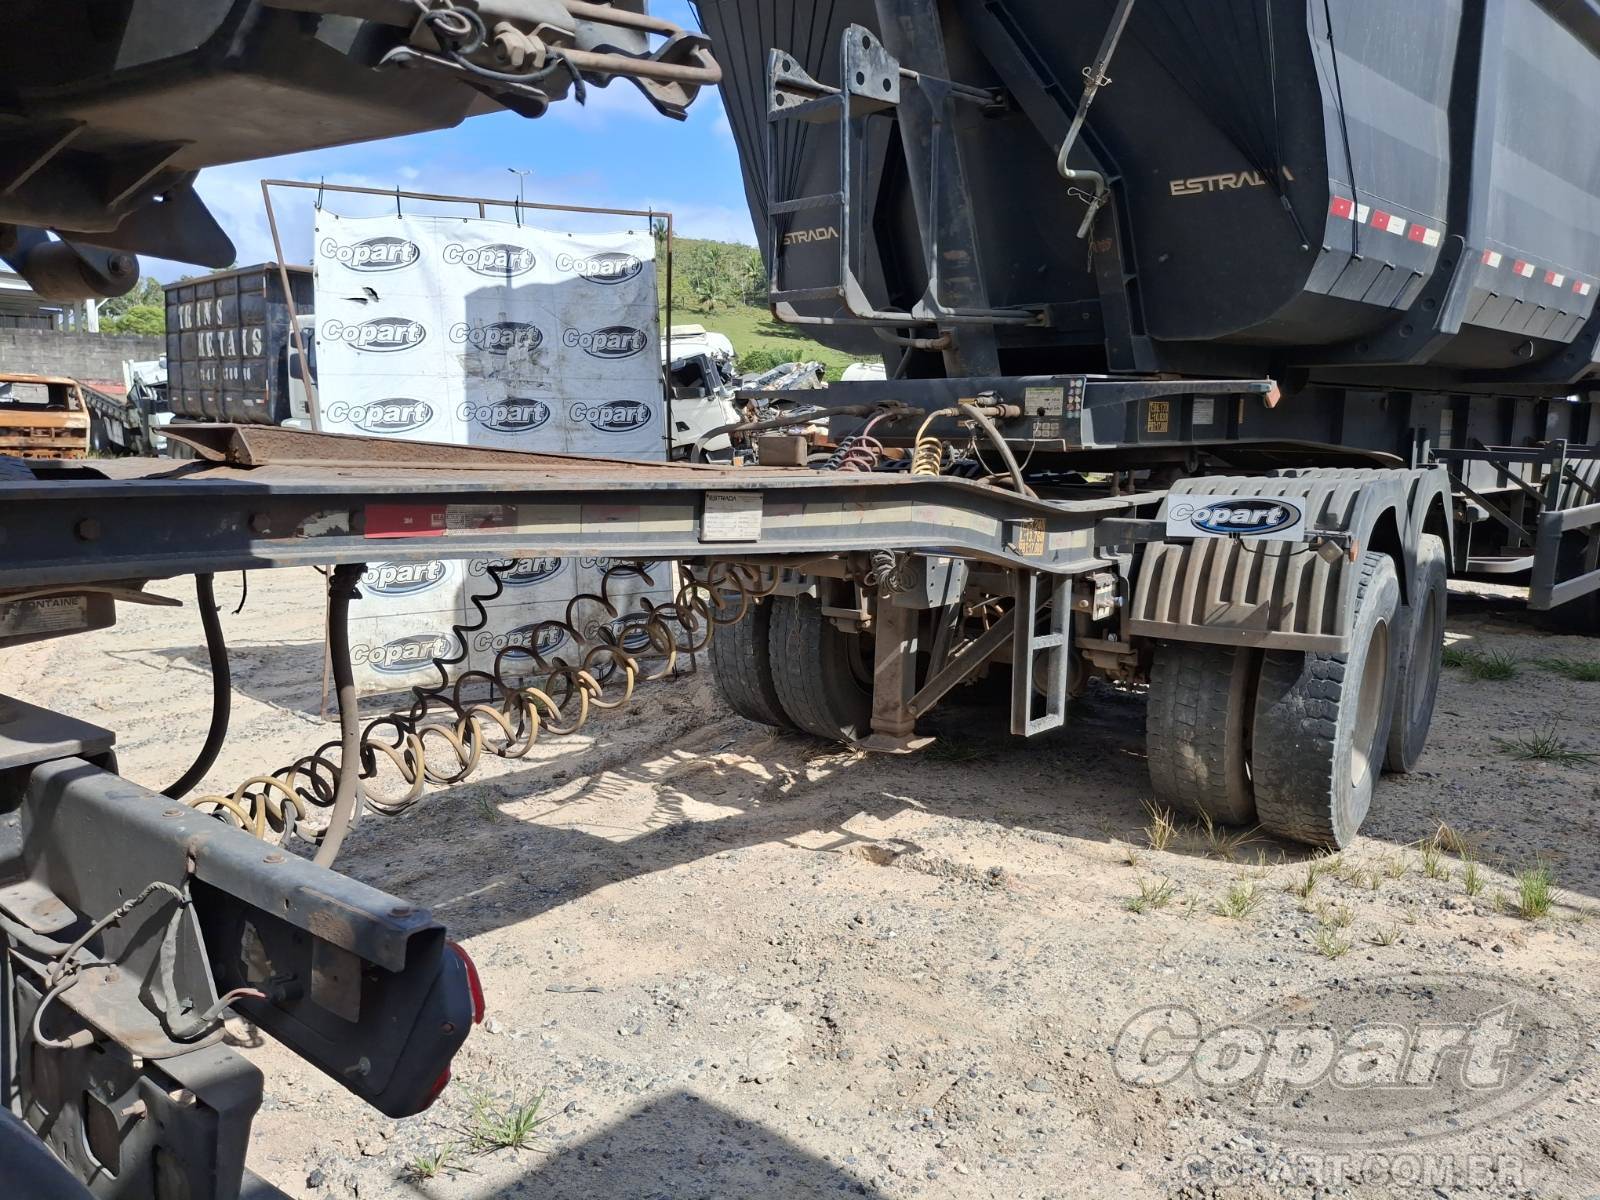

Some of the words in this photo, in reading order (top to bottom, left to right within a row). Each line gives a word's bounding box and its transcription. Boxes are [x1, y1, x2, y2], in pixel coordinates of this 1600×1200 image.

[783, 226, 839, 246] STRADA
[320, 237, 417, 273] Copart
[443, 243, 534, 274] Copart
[556, 252, 640, 281] Copart
[322, 319, 423, 348] Copart
[449, 322, 541, 351] Copart
[563, 327, 644, 354] Copart
[327, 400, 430, 430] Copart
[456, 401, 548, 430] Copart
[569, 401, 649, 429] Copart
[1170, 503, 1285, 526] Copart
[360, 559, 440, 589] opart
[349, 638, 447, 668] Copart
